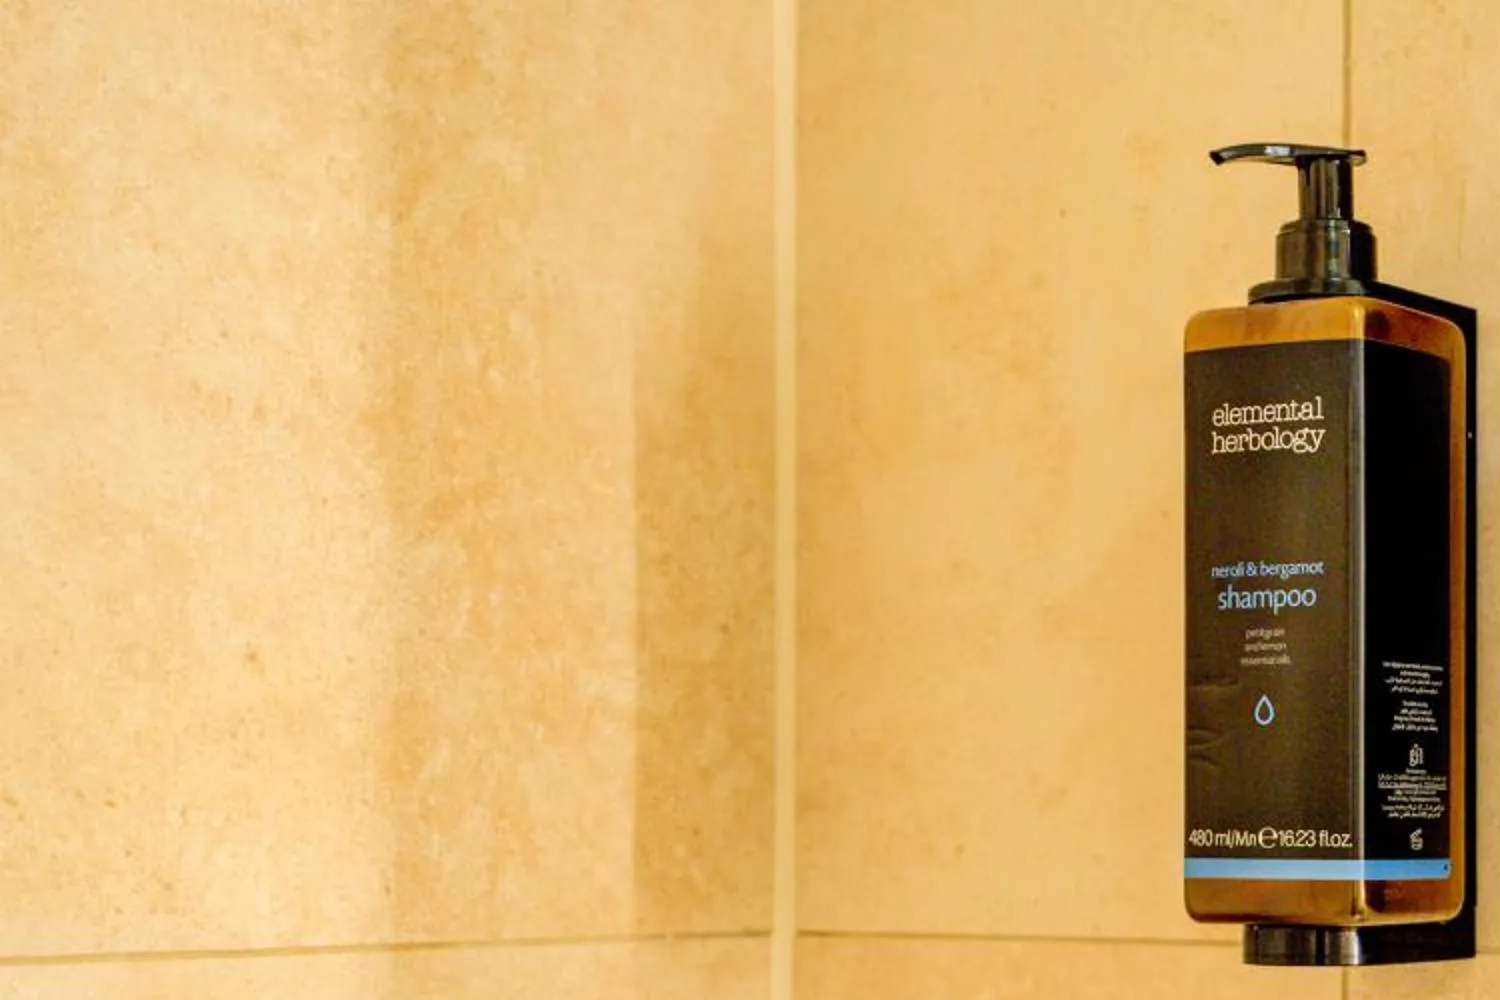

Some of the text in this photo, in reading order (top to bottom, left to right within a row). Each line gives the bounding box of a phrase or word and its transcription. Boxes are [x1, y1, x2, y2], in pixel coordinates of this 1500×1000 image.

[1212, 396, 1324, 426] elemental
[1211, 425, 1326, 454] herbology
[1212, 560, 1324, 581] neroli & bergamot
[1218, 584, 1317, 616] shampoo
[1189, 828, 1213, 847] 480
